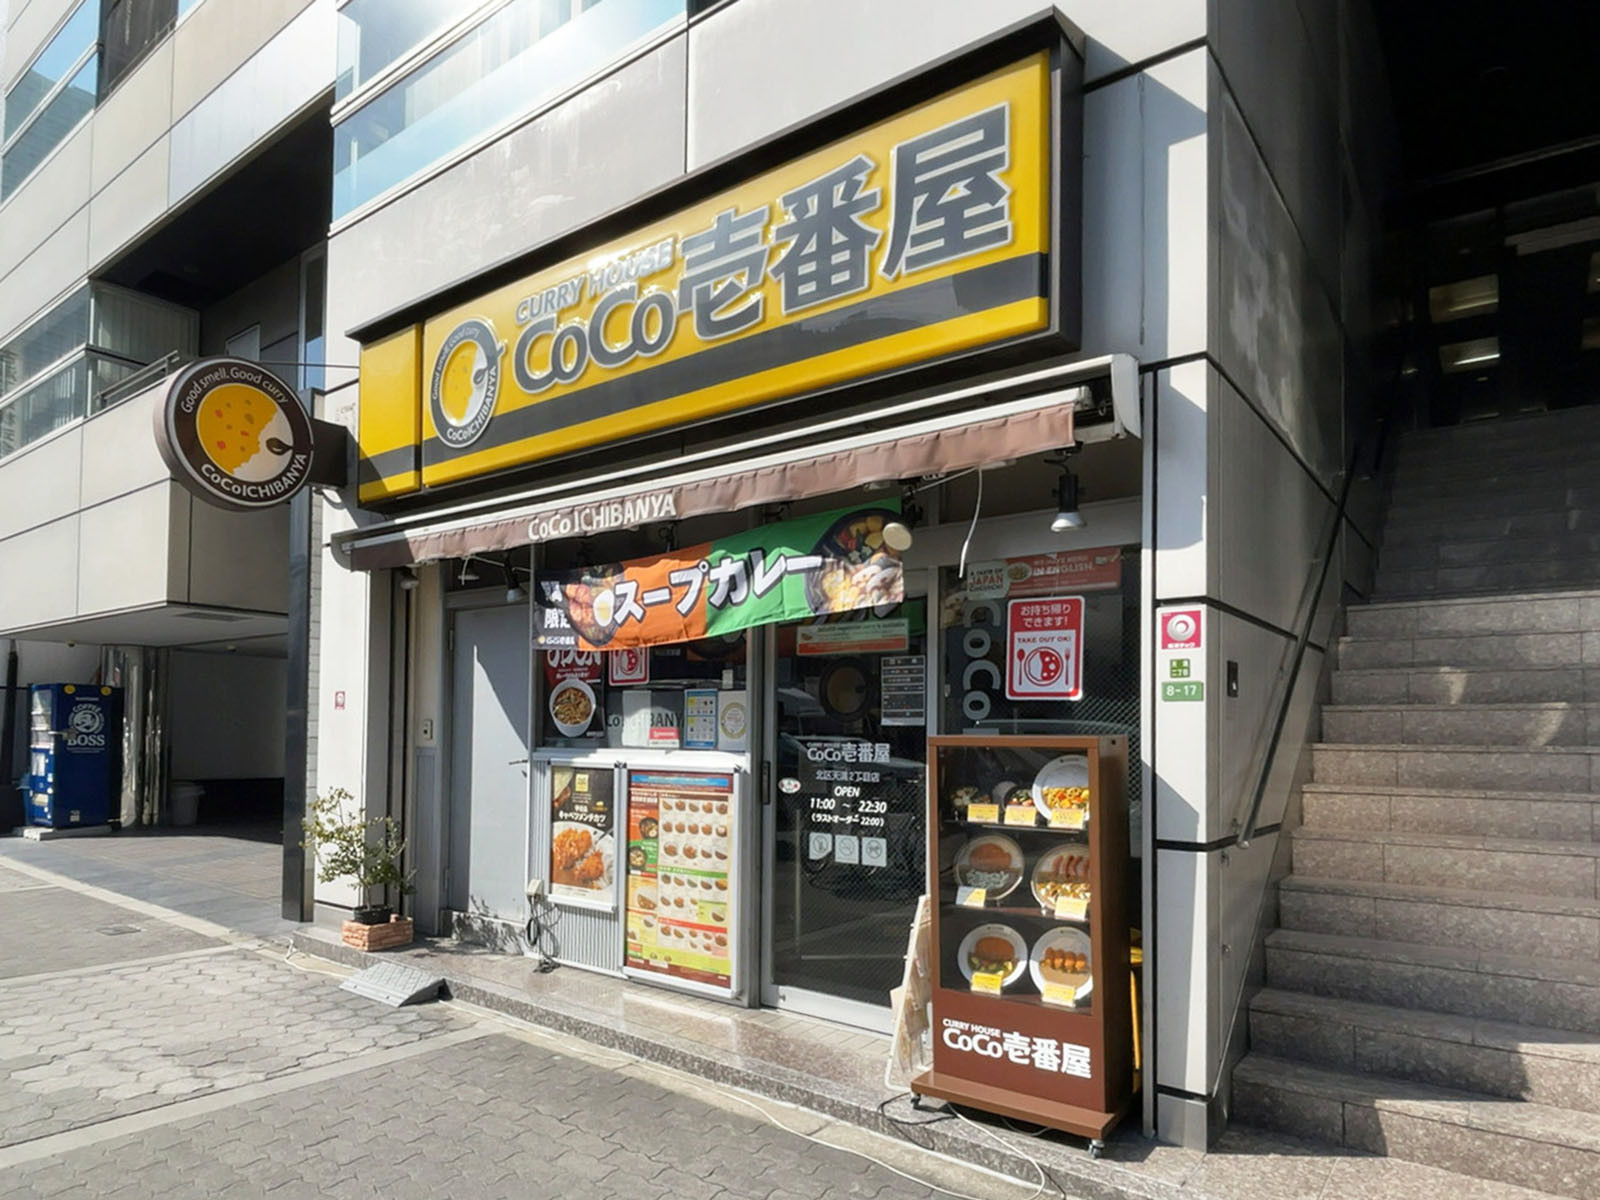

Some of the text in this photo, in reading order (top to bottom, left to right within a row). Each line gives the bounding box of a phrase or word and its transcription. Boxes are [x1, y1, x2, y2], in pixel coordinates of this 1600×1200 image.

[513, 101, 1013, 393] CoCo壱番屋
[516, 238, 675, 324] CURRY HOUSE
[181, 381, 202, 413] Good
[230, 367, 262, 384] Good
[262, 380, 289, 405] curry
[613, 549, 823, 624] スープカレー
[969, 574, 1003, 586] JAPAN
[1020, 603, 1072, 617] お持ち帰り
[1166, 685, 1197, 696] 8-17
[72, 703, 102, 713] COFFEE
[807, 743, 890, 762] CoCo壱番屋
[834, 786, 860, 797] OPEN
[810, 798, 836, 810] 11:00
[858, 801, 887, 813] 22:30
[943, 1018, 1001, 1038] CURRY HOUSE
[943, 1028, 1092, 1079] CoCo壱番屋
